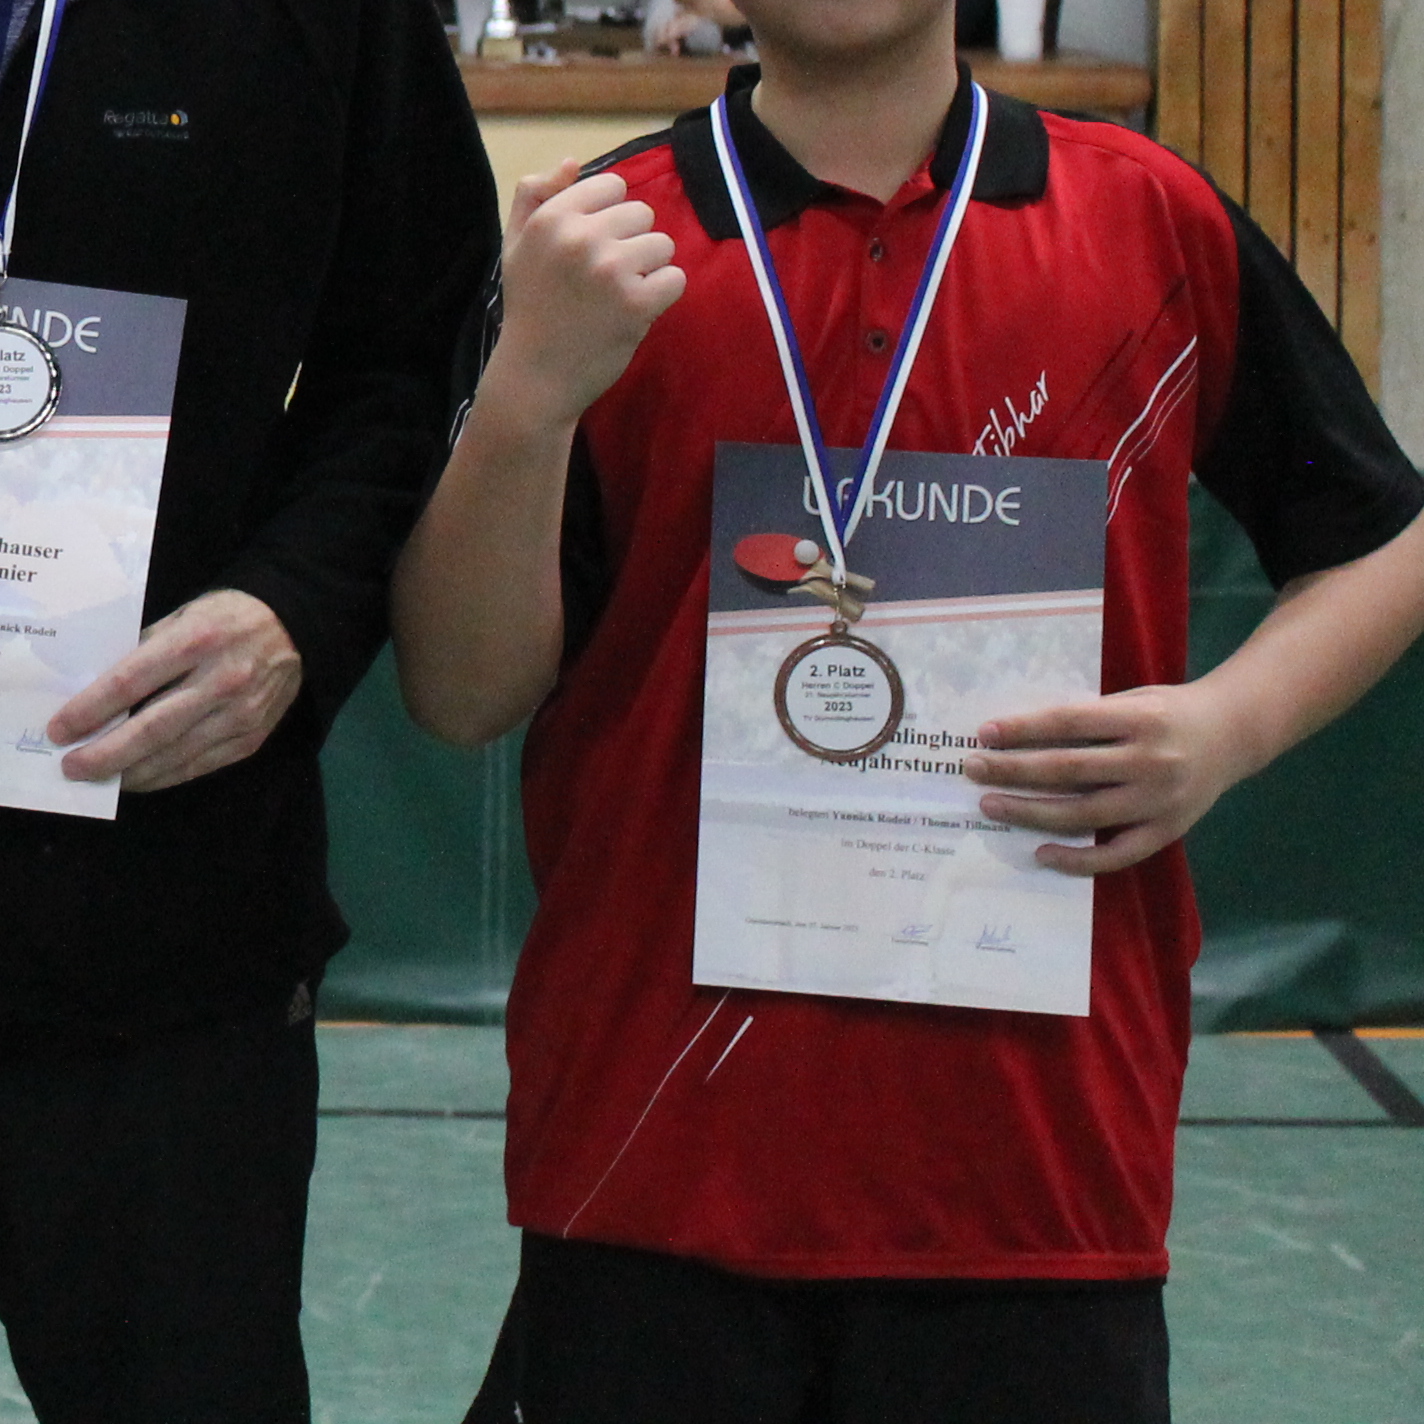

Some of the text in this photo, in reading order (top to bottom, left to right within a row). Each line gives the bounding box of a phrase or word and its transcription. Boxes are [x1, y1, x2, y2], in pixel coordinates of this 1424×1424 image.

[3, 365, 34, 374] Doppel
[810, 665, 866, 677] 2. Platz
[824, 701, 853, 711] 2023
[832, 810, 873, 822] Yannick
[921, 817, 960, 829] Thomas
[856, 839, 891, 852] Doppel
[912, 844, 955, 856] C-Klasse
[901, 870, 925, 881] Platz
